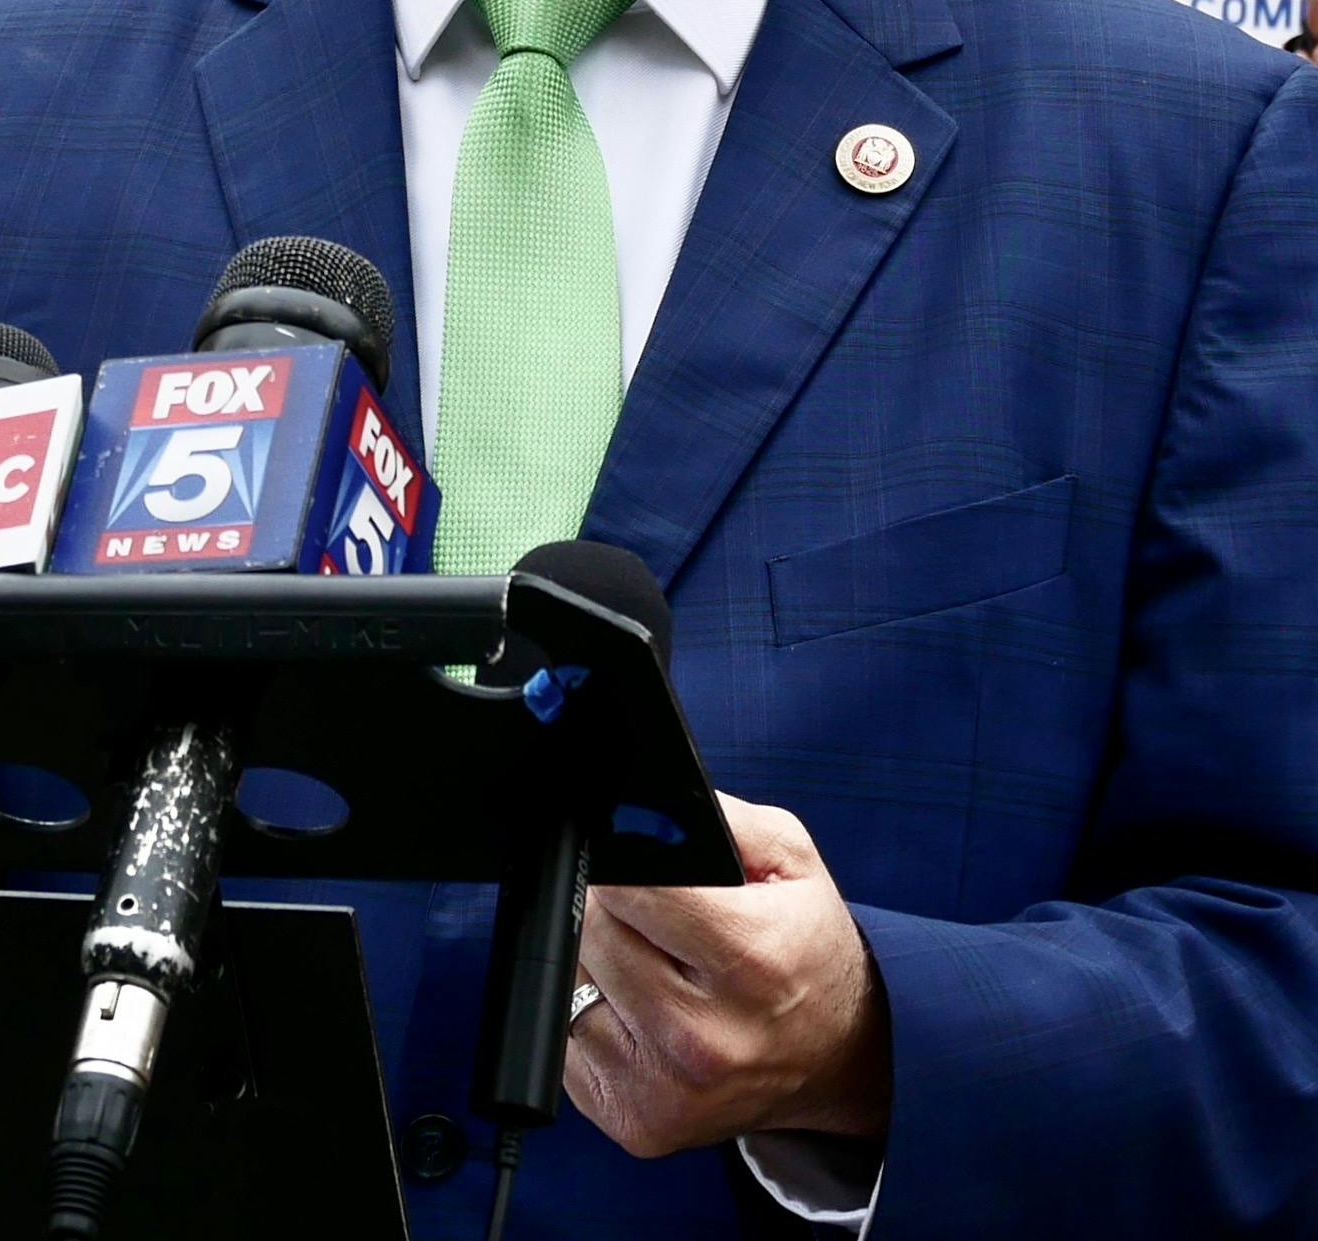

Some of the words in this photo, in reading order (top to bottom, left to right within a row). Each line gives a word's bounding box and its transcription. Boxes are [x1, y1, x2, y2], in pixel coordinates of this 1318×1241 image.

[152, 365, 273, 420] FOX
[143, 425, 245, 523] 5
[358, 406, 414, 519] FOX
[105, 531, 242, 558] NEWS
[345, 482, 395, 575] 5
